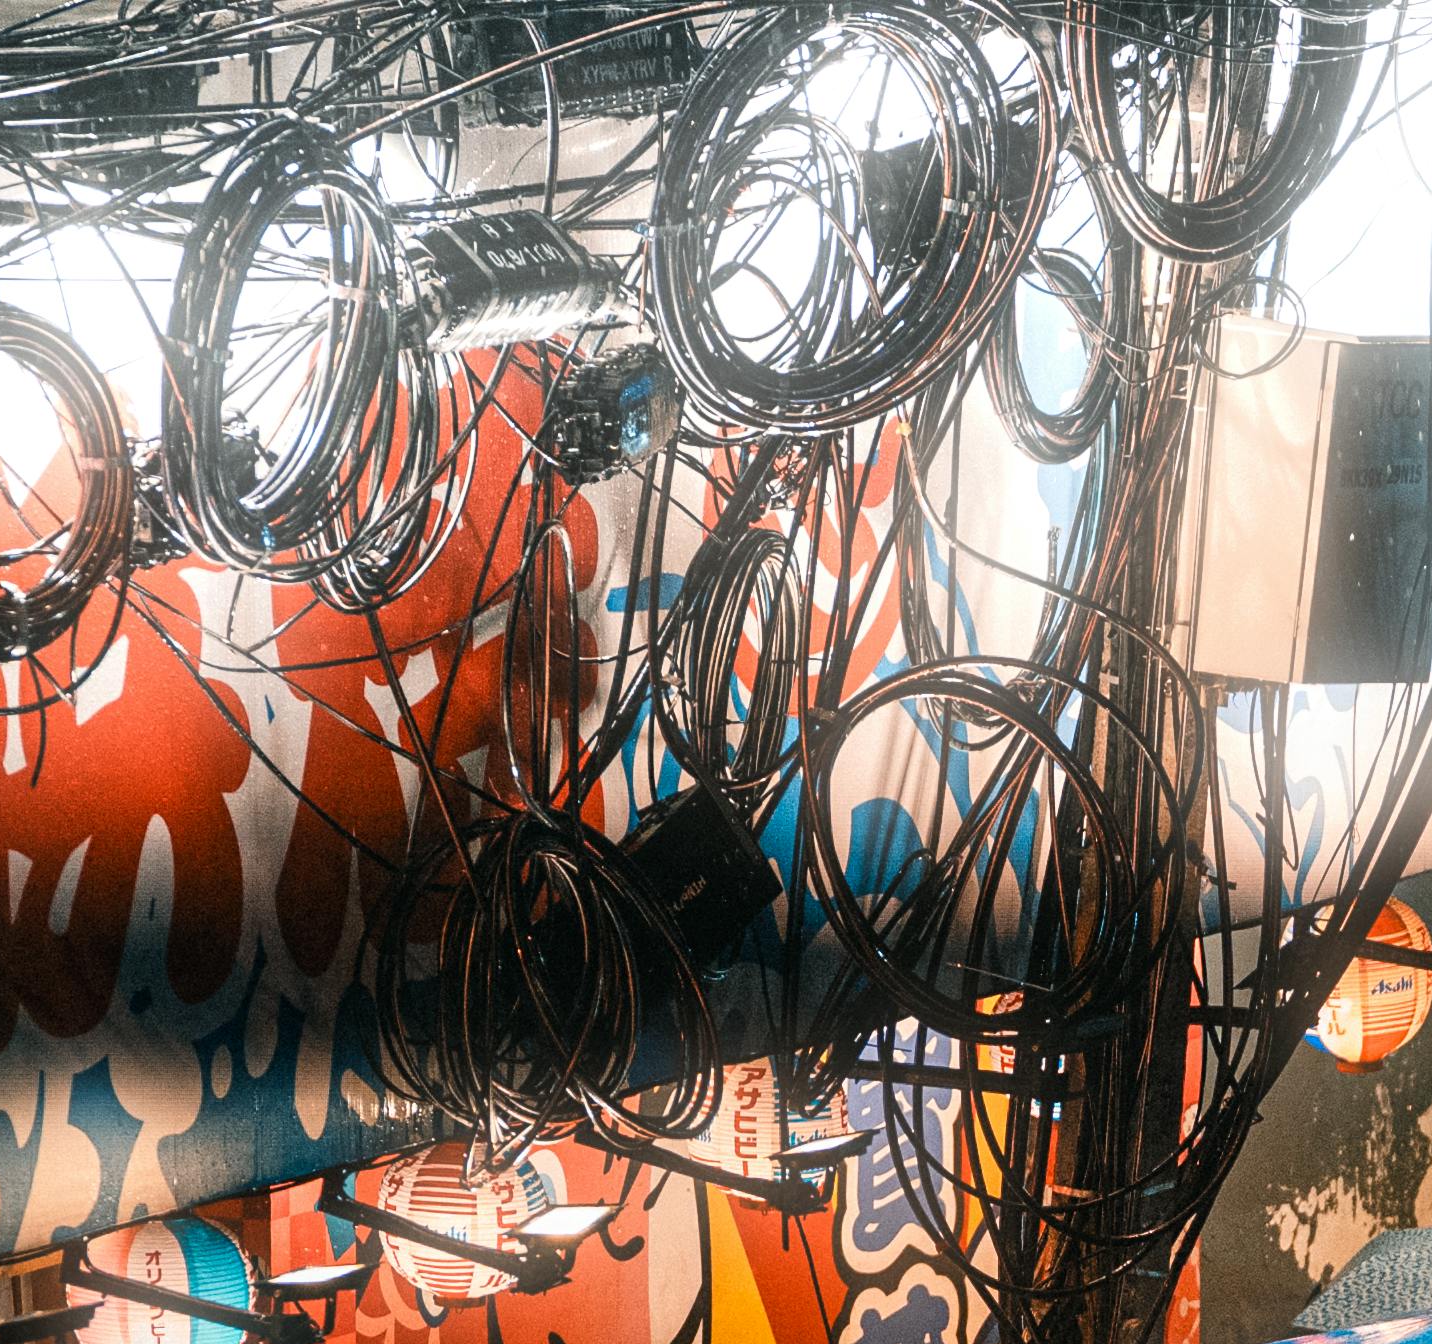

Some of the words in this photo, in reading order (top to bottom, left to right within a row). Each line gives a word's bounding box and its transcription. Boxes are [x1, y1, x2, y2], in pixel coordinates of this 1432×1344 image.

[1371, 975, 1413, 996] Asahi
[733, 1066, 767, 1178] アサヒビー
